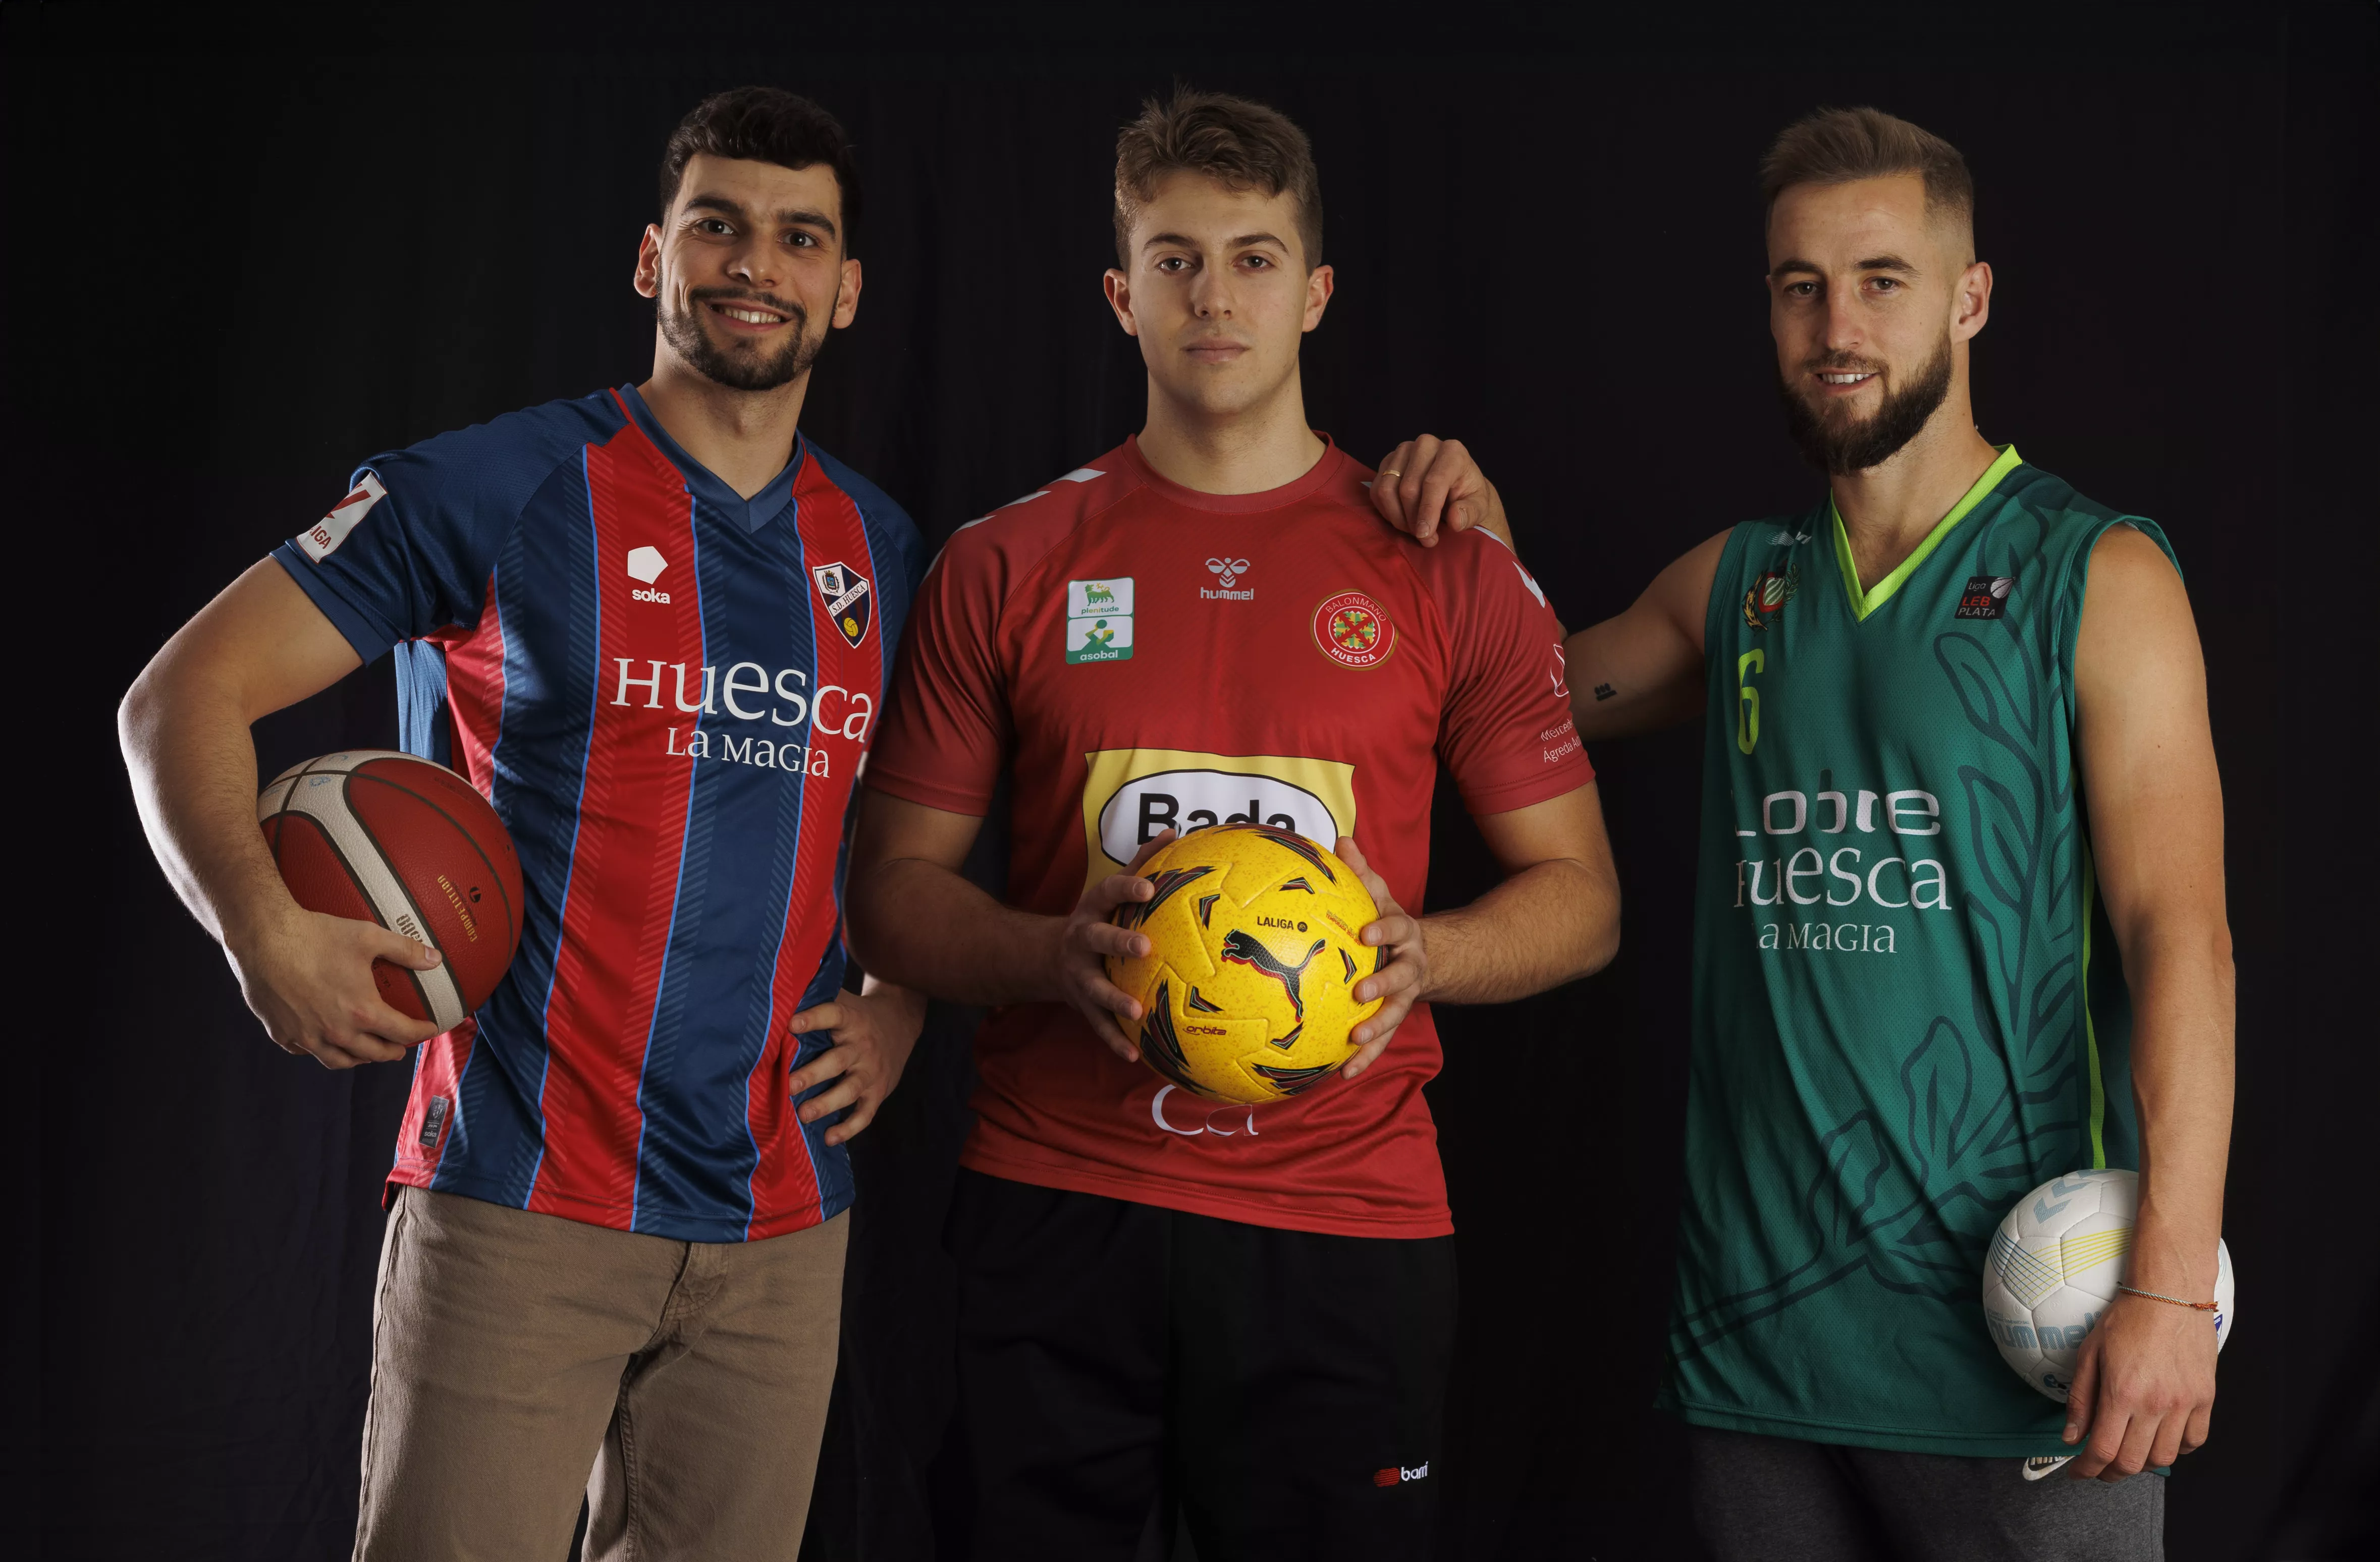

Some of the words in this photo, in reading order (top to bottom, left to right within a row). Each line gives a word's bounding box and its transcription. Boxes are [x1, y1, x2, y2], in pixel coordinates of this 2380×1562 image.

[309, 525, 332, 549] IGA
[1200, 586, 1254, 600] hummel
[1968, 582, 1986, 591] Liga
[632, 588, 670, 604] soka
[832, 602, 845, 613] S.D.
[844, 584, 866, 605] HUESCA
[1962, 596, 1991, 606] LEB
[1081, 606, 1119, 615] plenitude
[1325, 597, 1387, 622] BALONMANO
[1958, 607, 1995, 617] PLATA
[1080, 649, 1118, 660] asobal
[1330, 647, 1376, 663] HUESCA
[610, 657, 873, 743] Huesca
[1738, 648, 1764, 755] 6
[665, 727, 712, 758] La
[1543, 742, 1574, 763] Ágreda
[1257, 916, 1294, 930] LALIGA
[1758, 923, 1779, 950] a
[1186, 1025, 1227, 1036] orbita
